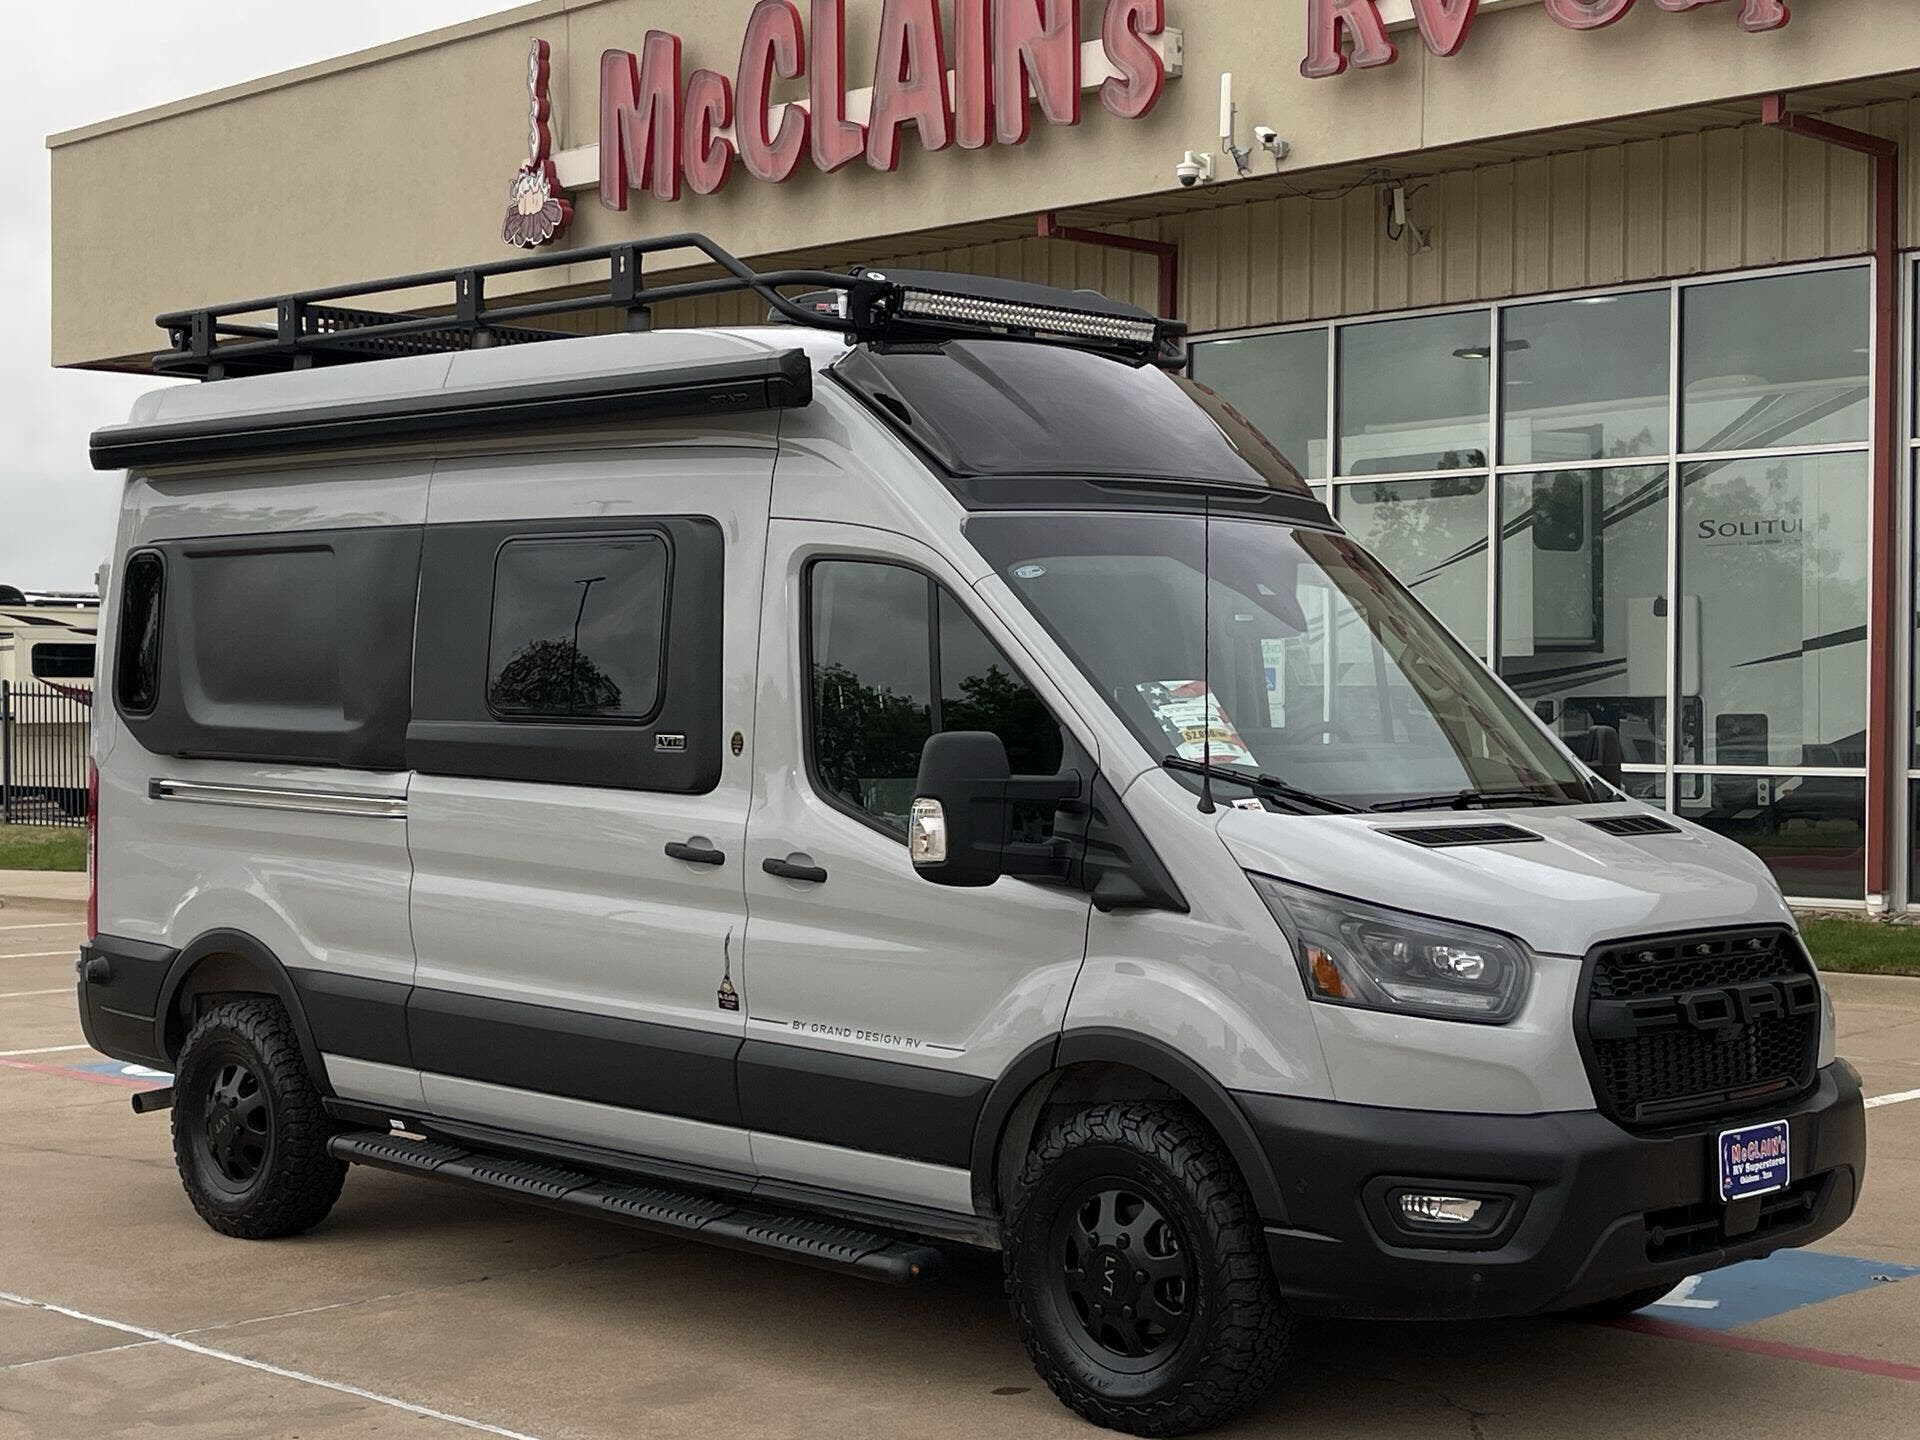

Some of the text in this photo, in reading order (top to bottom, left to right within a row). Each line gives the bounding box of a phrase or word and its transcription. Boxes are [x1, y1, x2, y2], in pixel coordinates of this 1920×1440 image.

[1698, 519, 1802, 538] SOLITU
[1625, 977, 1818, 1036] FORD
[792, 1020, 921, 1048] BY GRAND DESIGN RV
[1733, 1157, 1786, 1175] RV Superstores
[1103, 1256, 1116, 1296] LVT
